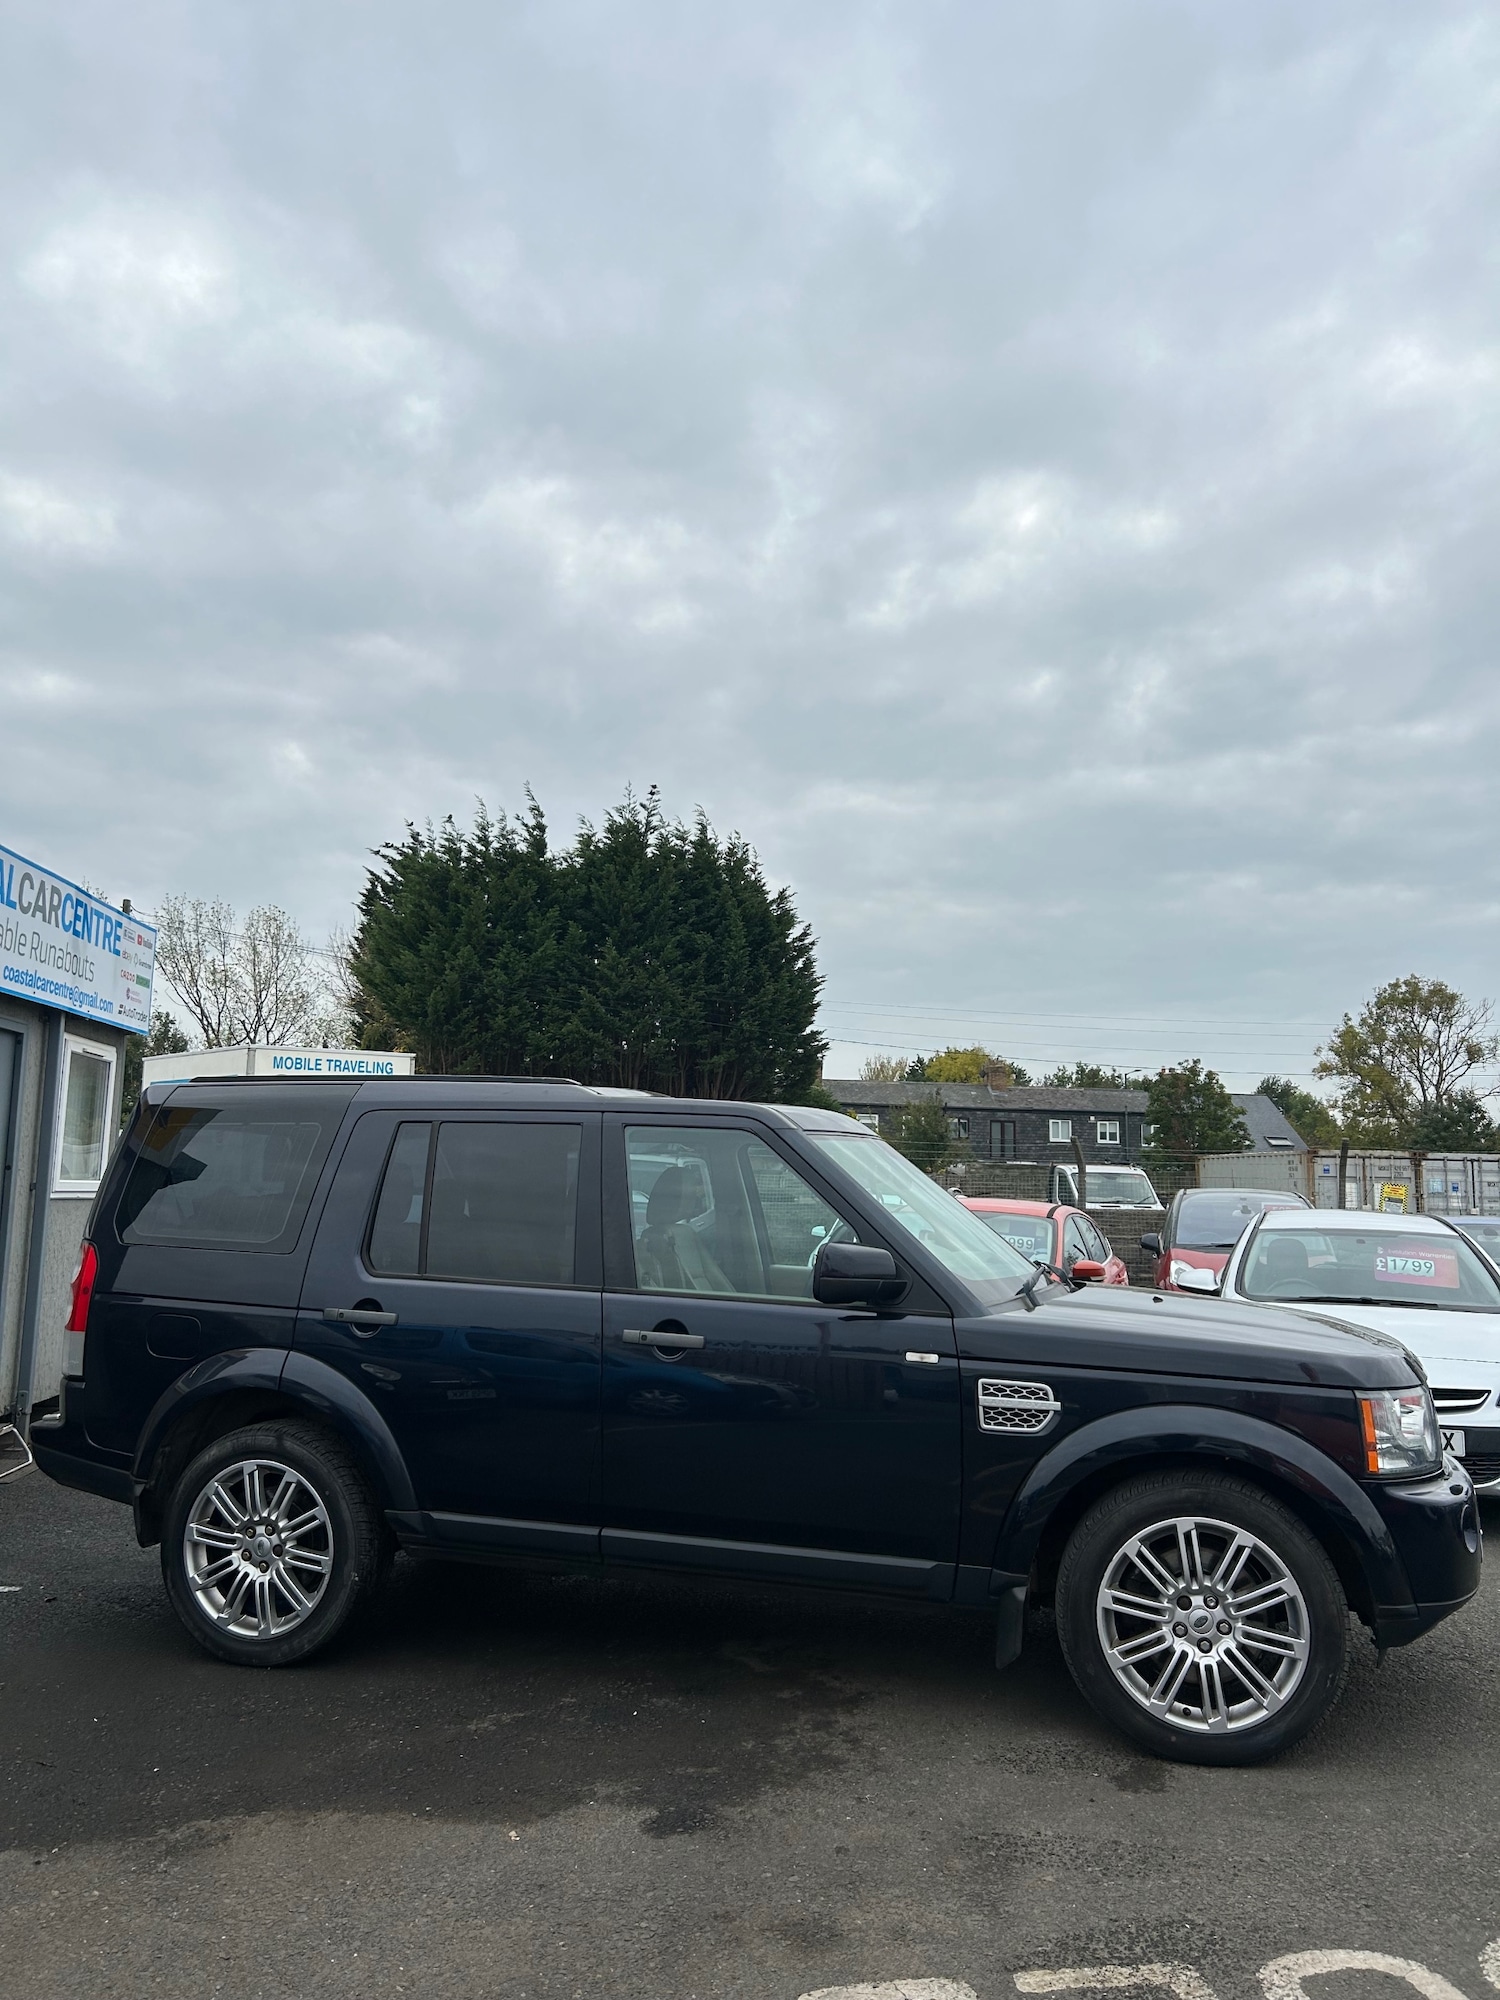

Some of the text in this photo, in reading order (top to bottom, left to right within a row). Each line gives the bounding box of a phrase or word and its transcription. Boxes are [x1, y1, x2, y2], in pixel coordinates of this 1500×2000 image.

[30, 931, 95, 982] Runabouts
[3, 965, 114, 1014] coastalcarcentre@gmail.com
[273, 1056, 394, 1075] MOBILE TRAVELING
[1003, 1236, 1033, 1250] 999
[1419, 1251, 1456, 1260] Warranties
[1442, 1432, 1455, 1451] X
